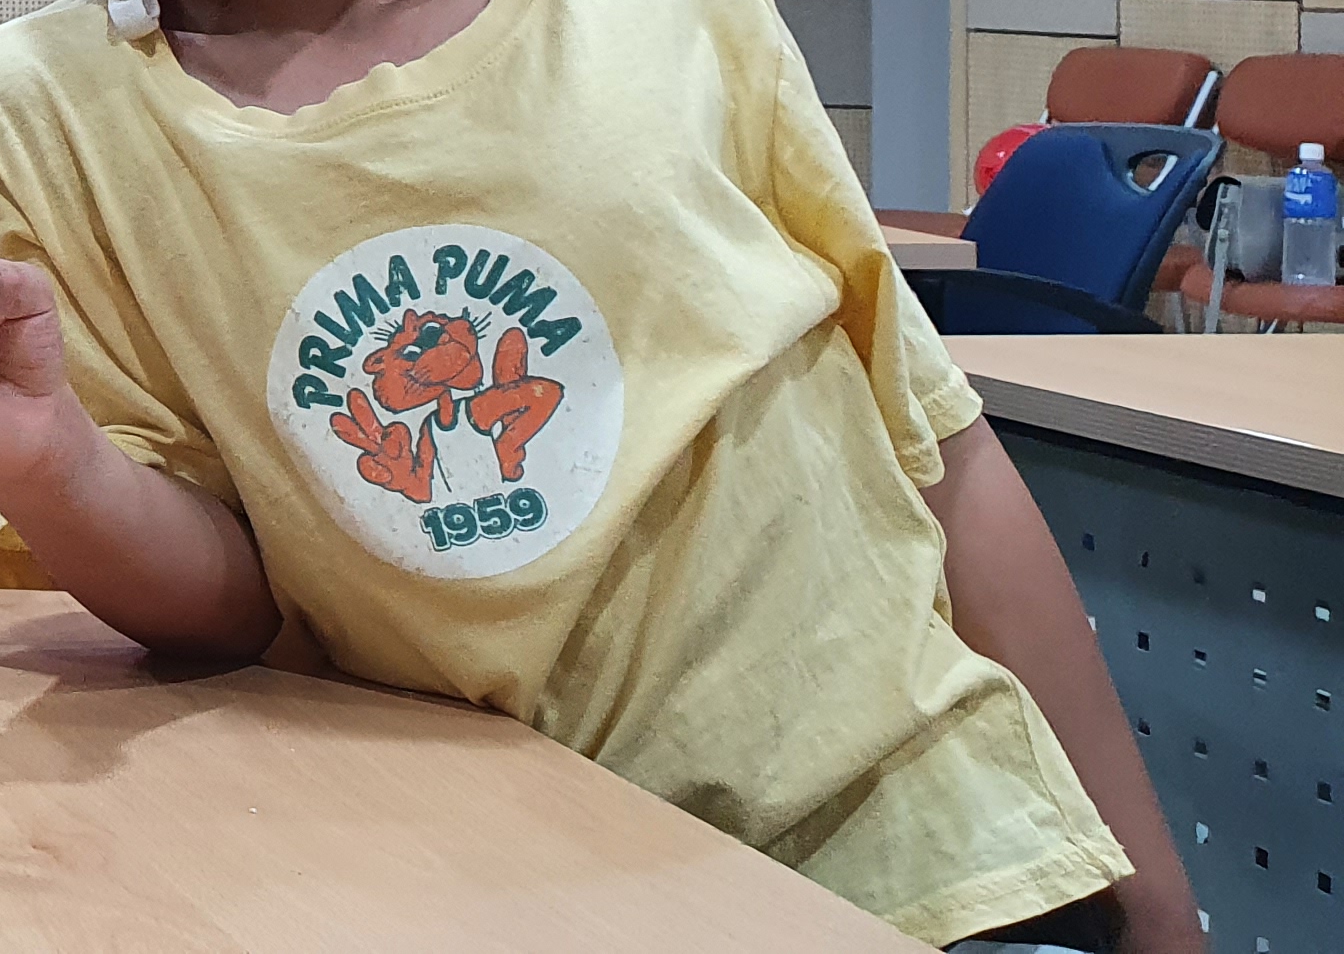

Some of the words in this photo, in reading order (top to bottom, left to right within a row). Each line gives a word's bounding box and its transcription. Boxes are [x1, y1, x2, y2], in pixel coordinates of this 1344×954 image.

[292, 254, 421, 409] PRIMA
[432, 245, 582, 357] PUMA
[421, 488, 548, 552] 1959
